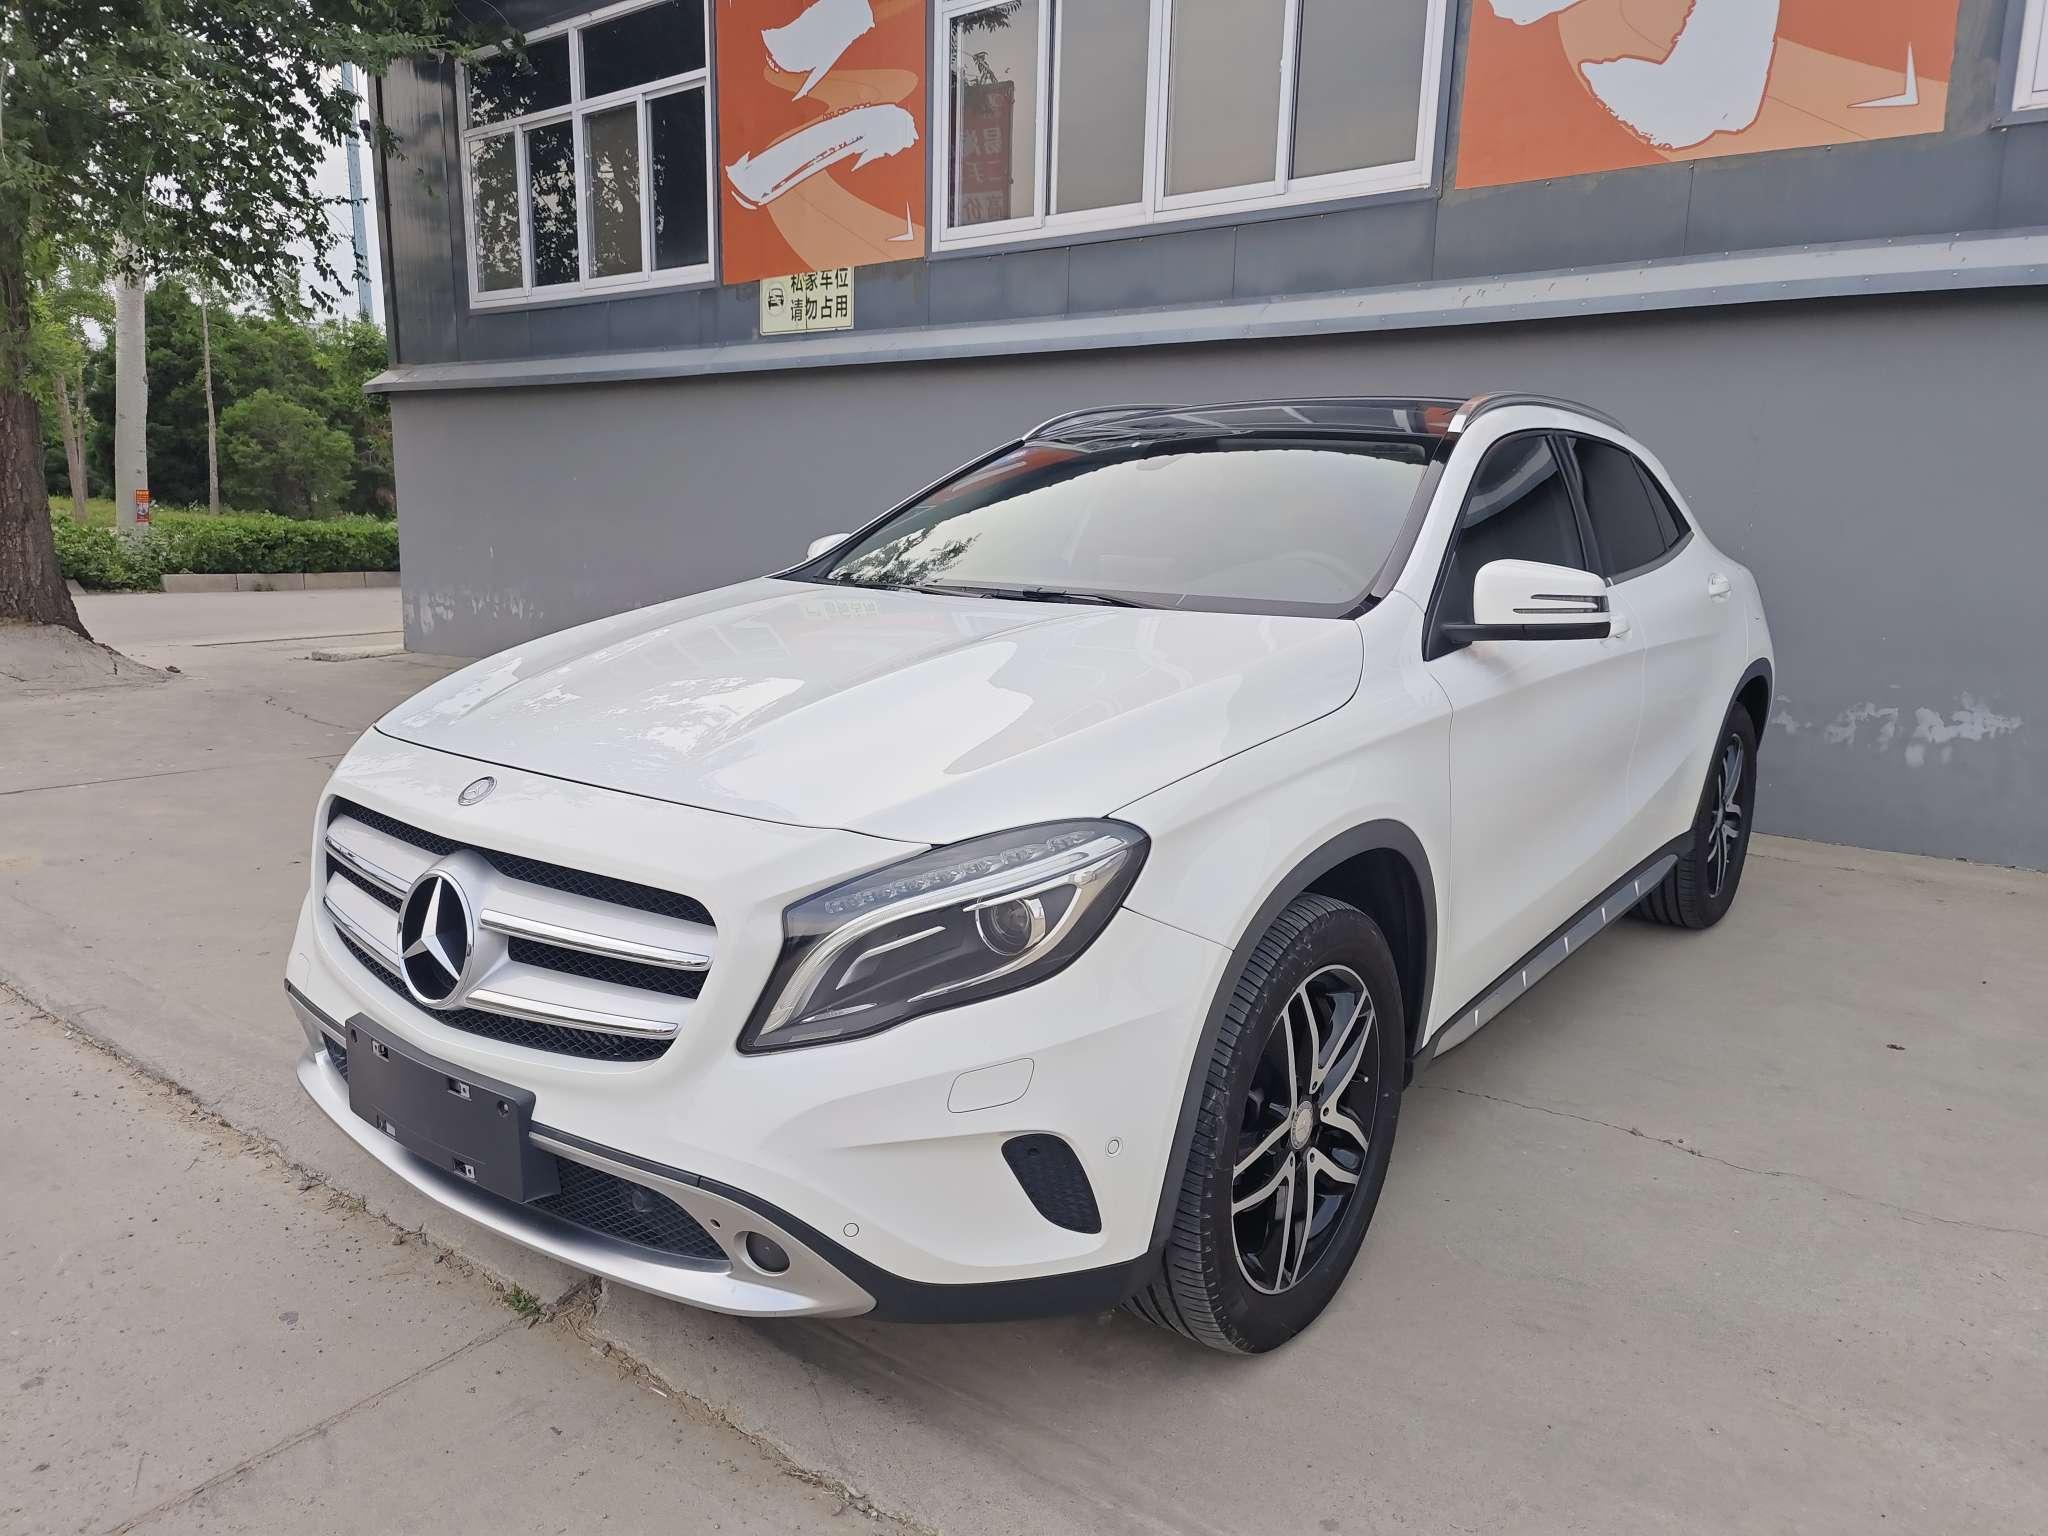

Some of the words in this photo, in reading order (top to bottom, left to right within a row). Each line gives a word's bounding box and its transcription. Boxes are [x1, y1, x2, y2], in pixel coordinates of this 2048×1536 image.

[790, 267, 849, 293] 私家车位
[790, 294, 848, 321] 请勿占用
